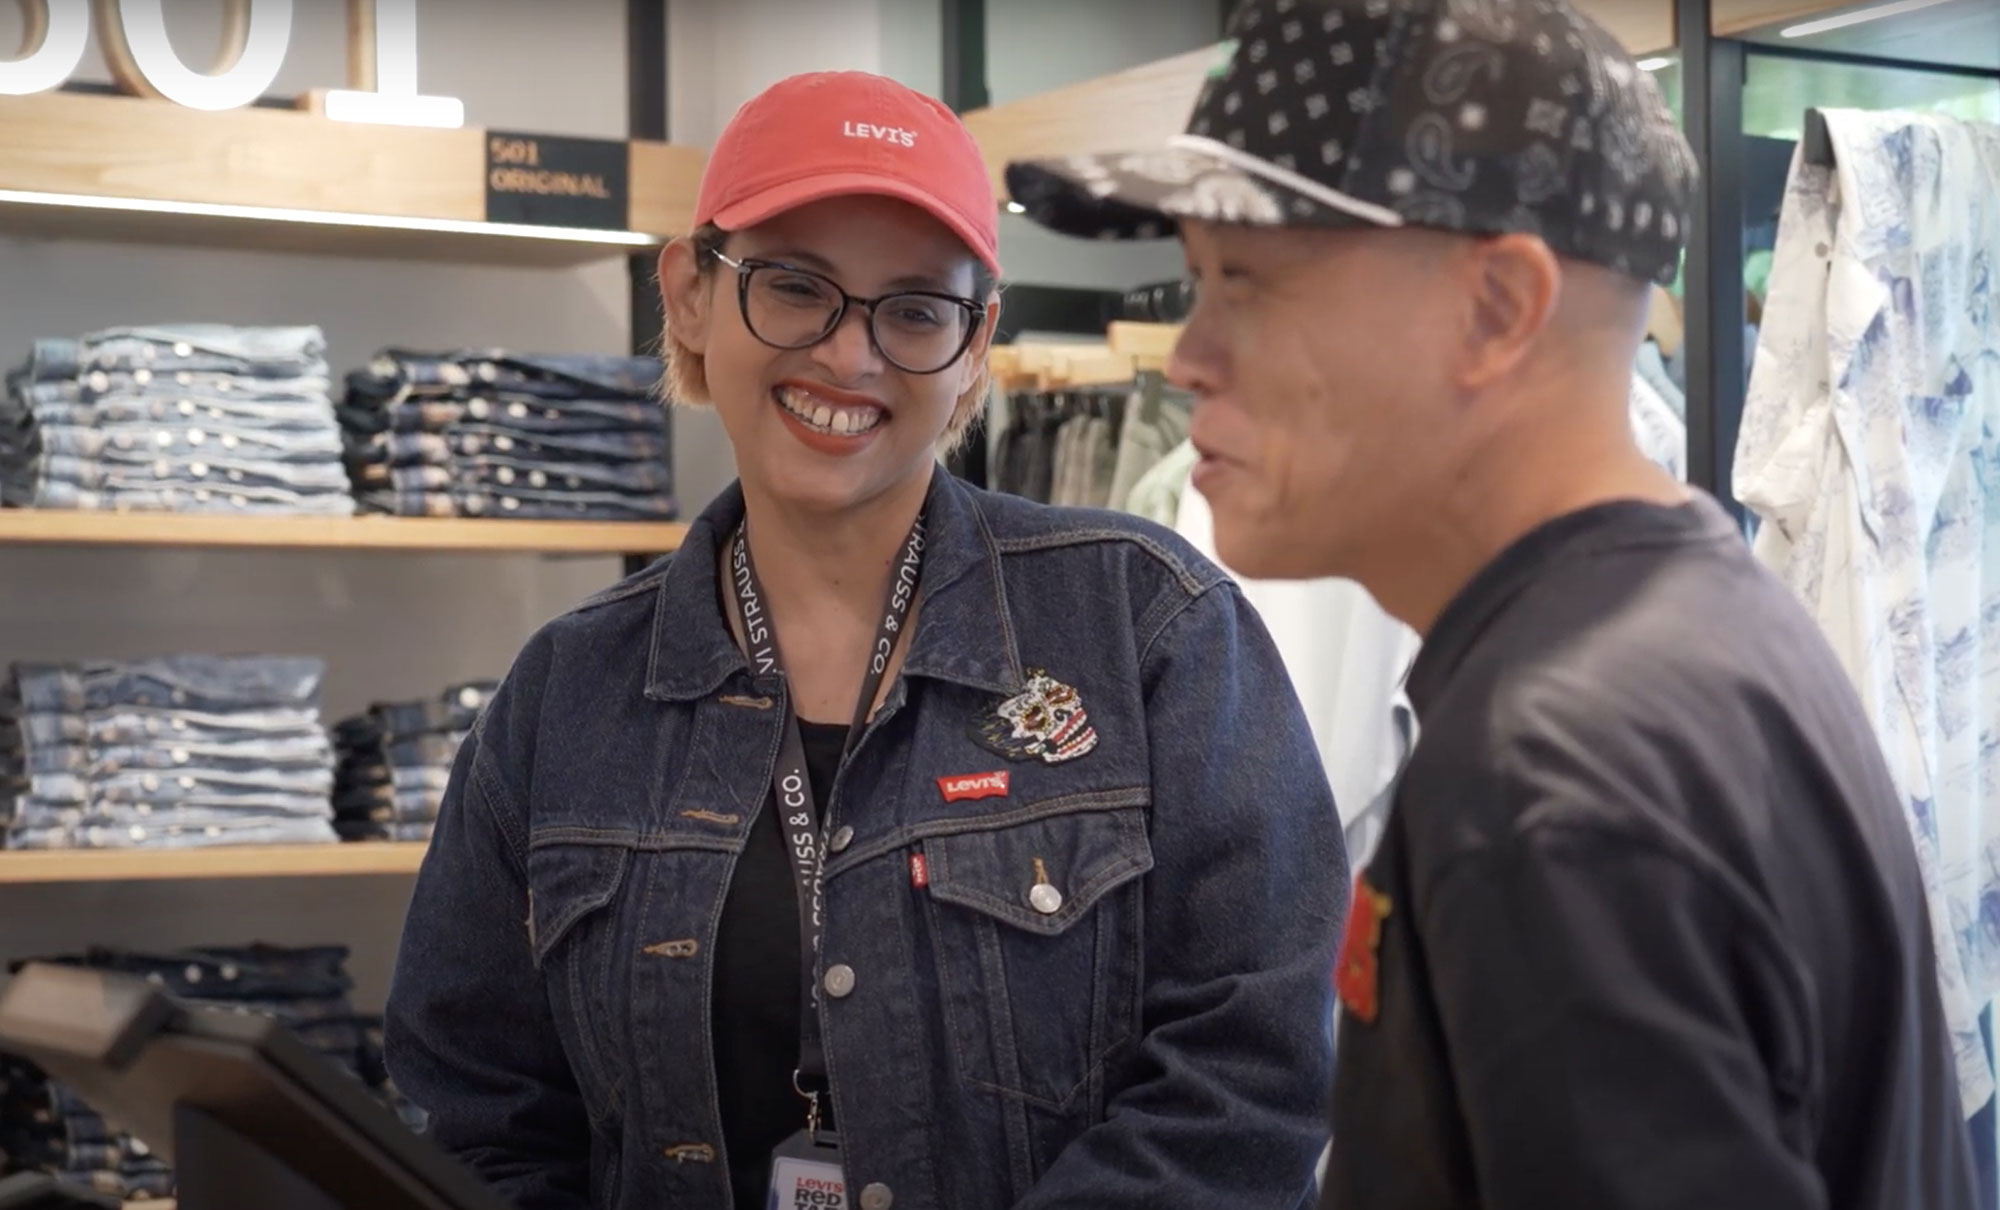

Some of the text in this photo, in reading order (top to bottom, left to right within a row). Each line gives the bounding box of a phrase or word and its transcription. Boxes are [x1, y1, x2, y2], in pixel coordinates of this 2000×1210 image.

[843, 120, 915, 148] LEVI'S
[490, 137, 539, 165] 501
[490, 167, 610, 199] ORIGINAL
[733, 538, 768, 645] STRAUSS
[884, 615, 900, 632] &
[870, 638, 891, 675] CO.
[782, 768, 805, 808] CO.
[789, 812, 809, 826] &
